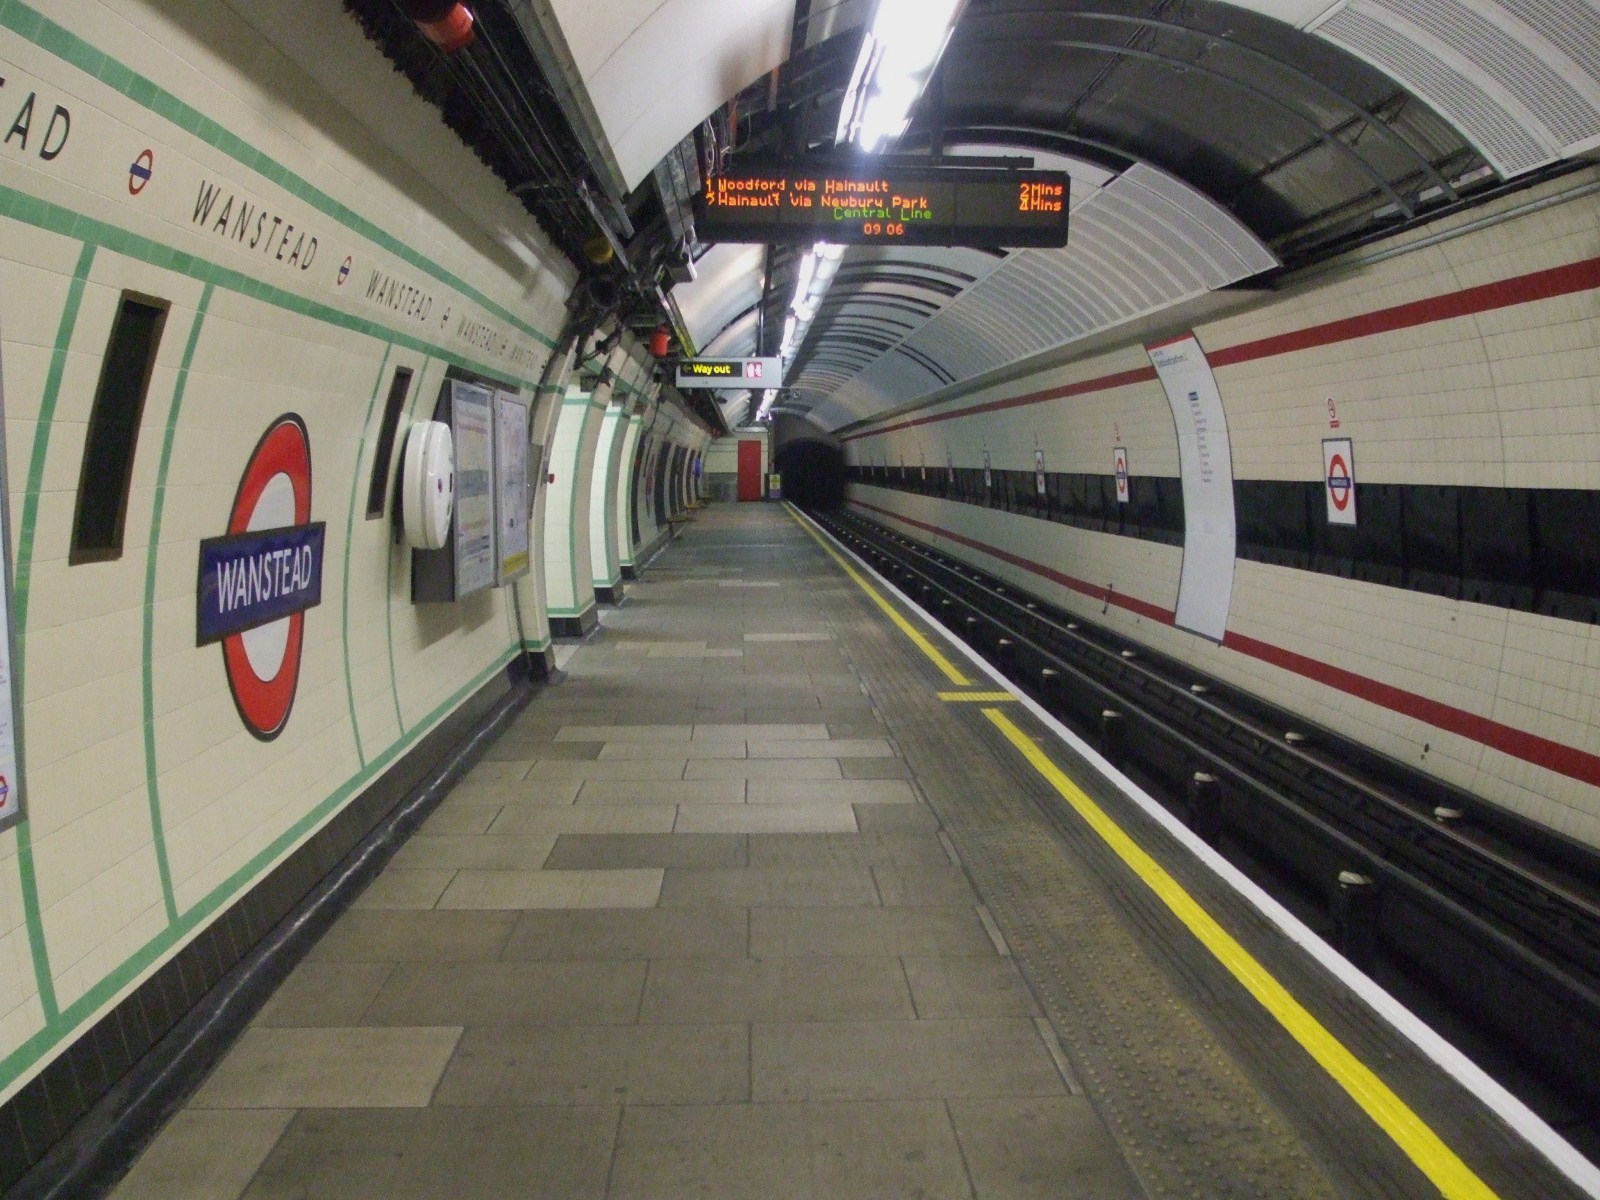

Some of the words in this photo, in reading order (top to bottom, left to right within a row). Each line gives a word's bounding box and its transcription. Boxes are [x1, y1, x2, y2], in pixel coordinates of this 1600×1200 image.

[0, 77, 71, 161] AD
[718, 178, 786, 192] Woodford
[794, 180, 816, 191] via
[825, 179, 889, 193] Hainault
[718, 193, 780, 206] Hainault
[790, 194, 812, 207] via
[821, 196, 883, 208] Newbury
[892, 196, 929, 209] Park
[193, 179, 318, 270] WANSTEAD
[833, 207, 891, 220] Central
[901, 207, 932, 221] Line
[366, 269, 433, 321] WANSTEAD
[692, 364, 713, 375] Way
[713, 365, 731, 374] out
[217, 544, 312, 614] WANSTEAD
